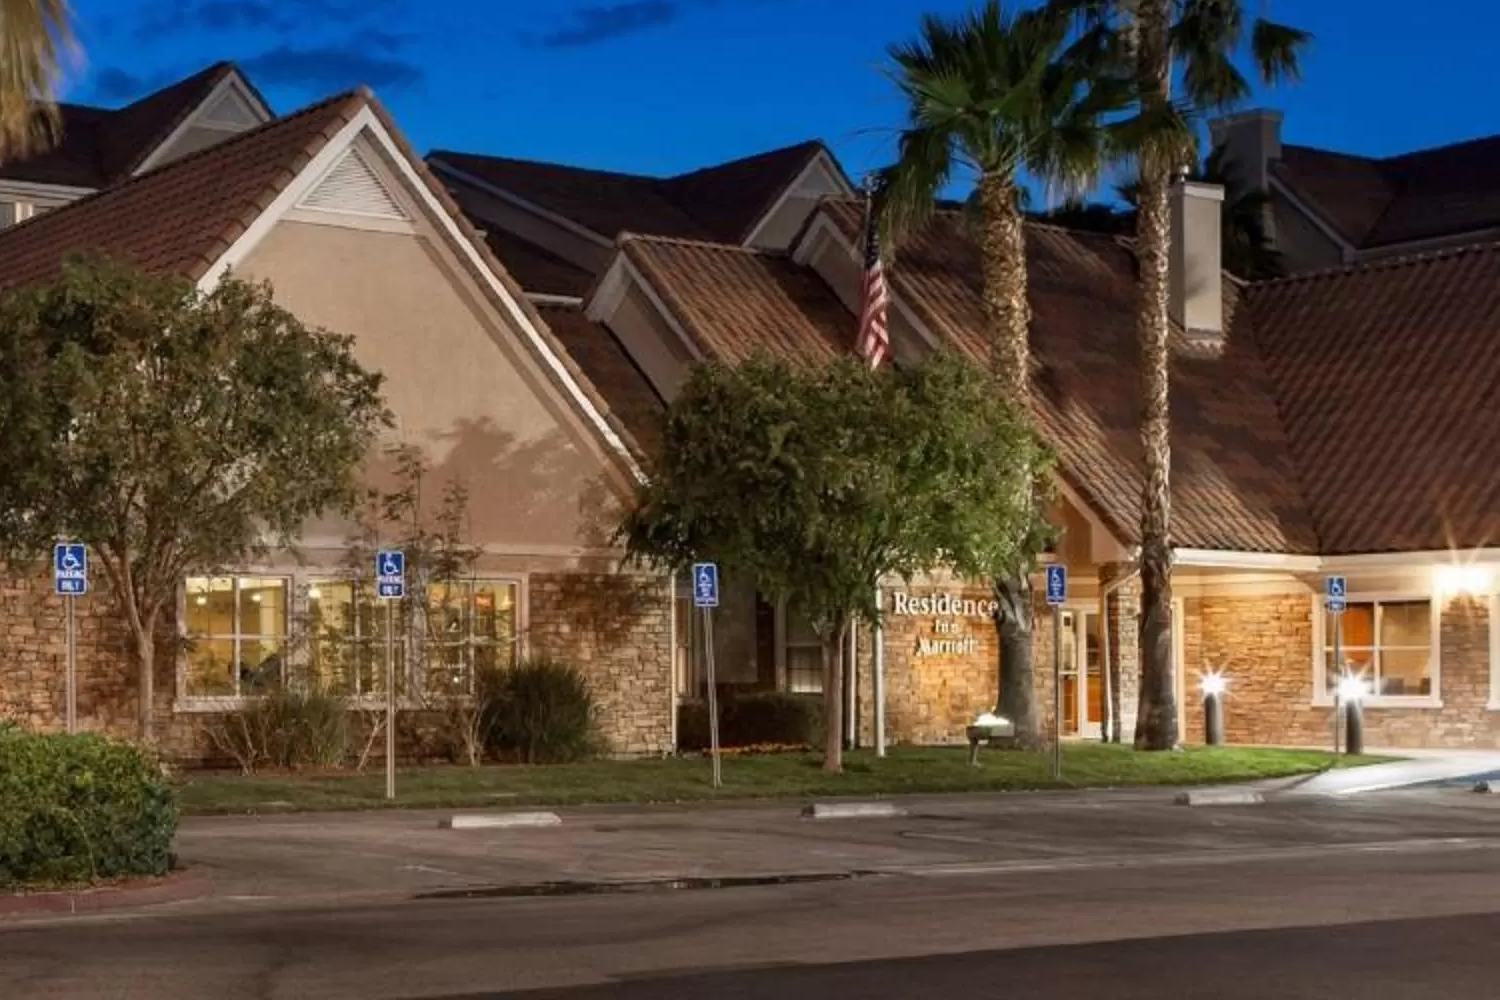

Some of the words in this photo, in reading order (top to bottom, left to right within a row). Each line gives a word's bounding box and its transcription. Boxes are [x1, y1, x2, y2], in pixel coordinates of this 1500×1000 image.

[893, 592, 999, 617] Residence
[935, 619, 958, 633] Inn
[917, 634, 976, 656] Marriott
